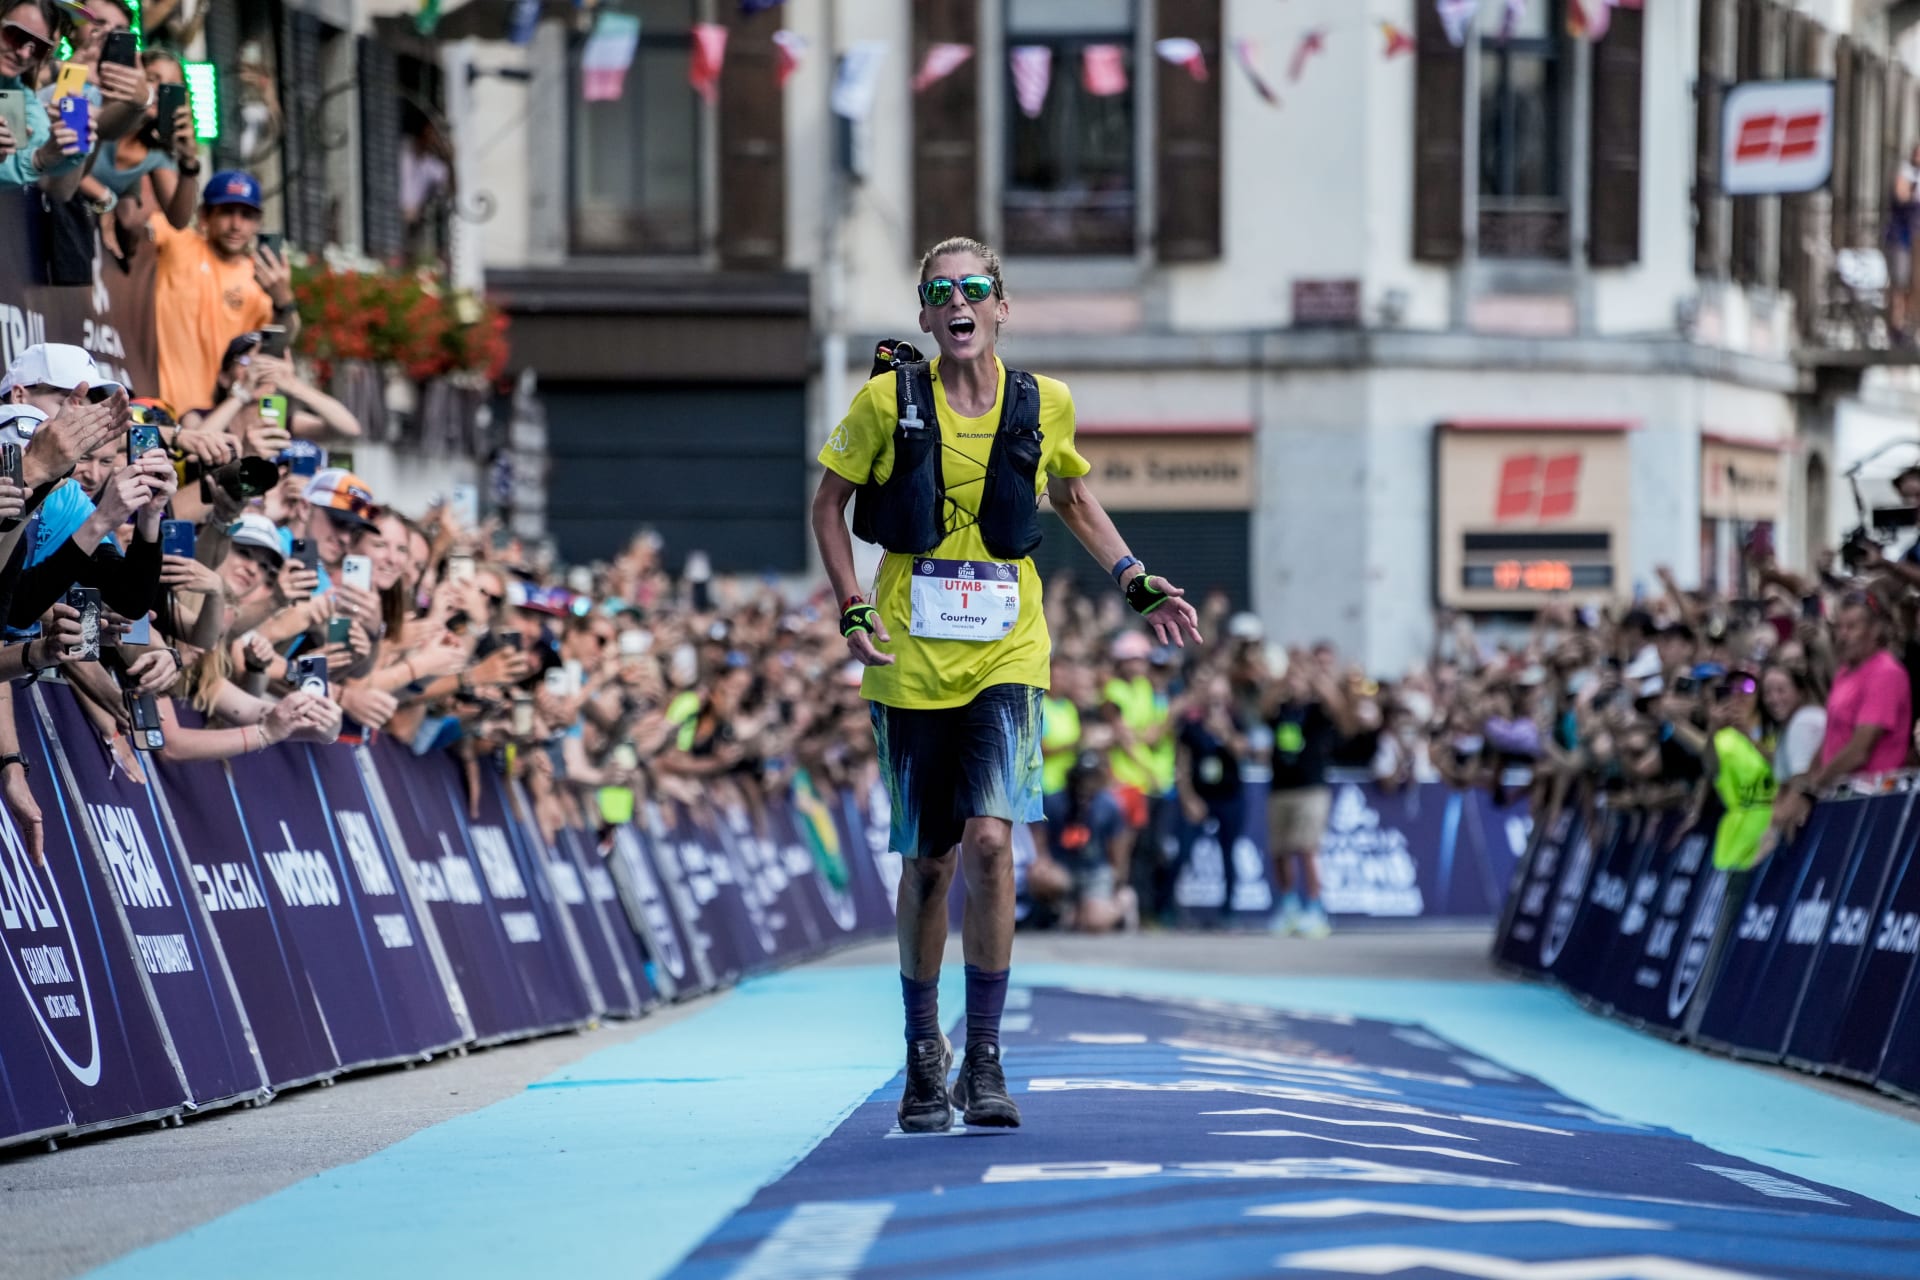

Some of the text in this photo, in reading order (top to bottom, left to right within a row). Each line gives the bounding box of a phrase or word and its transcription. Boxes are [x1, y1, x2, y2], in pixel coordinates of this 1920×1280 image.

[956, 431, 996, 439] SALOMON
[945, 579, 982, 592] UTMB
[961, 593, 968, 609] 1
[940, 612, 988, 626] Courtney
[87, 803, 172, 908] HOKA
[262, 820, 341, 907] wahoo
[192, 863, 266, 912] DACIA
[20, 944, 74, 985] CHAMONIX
